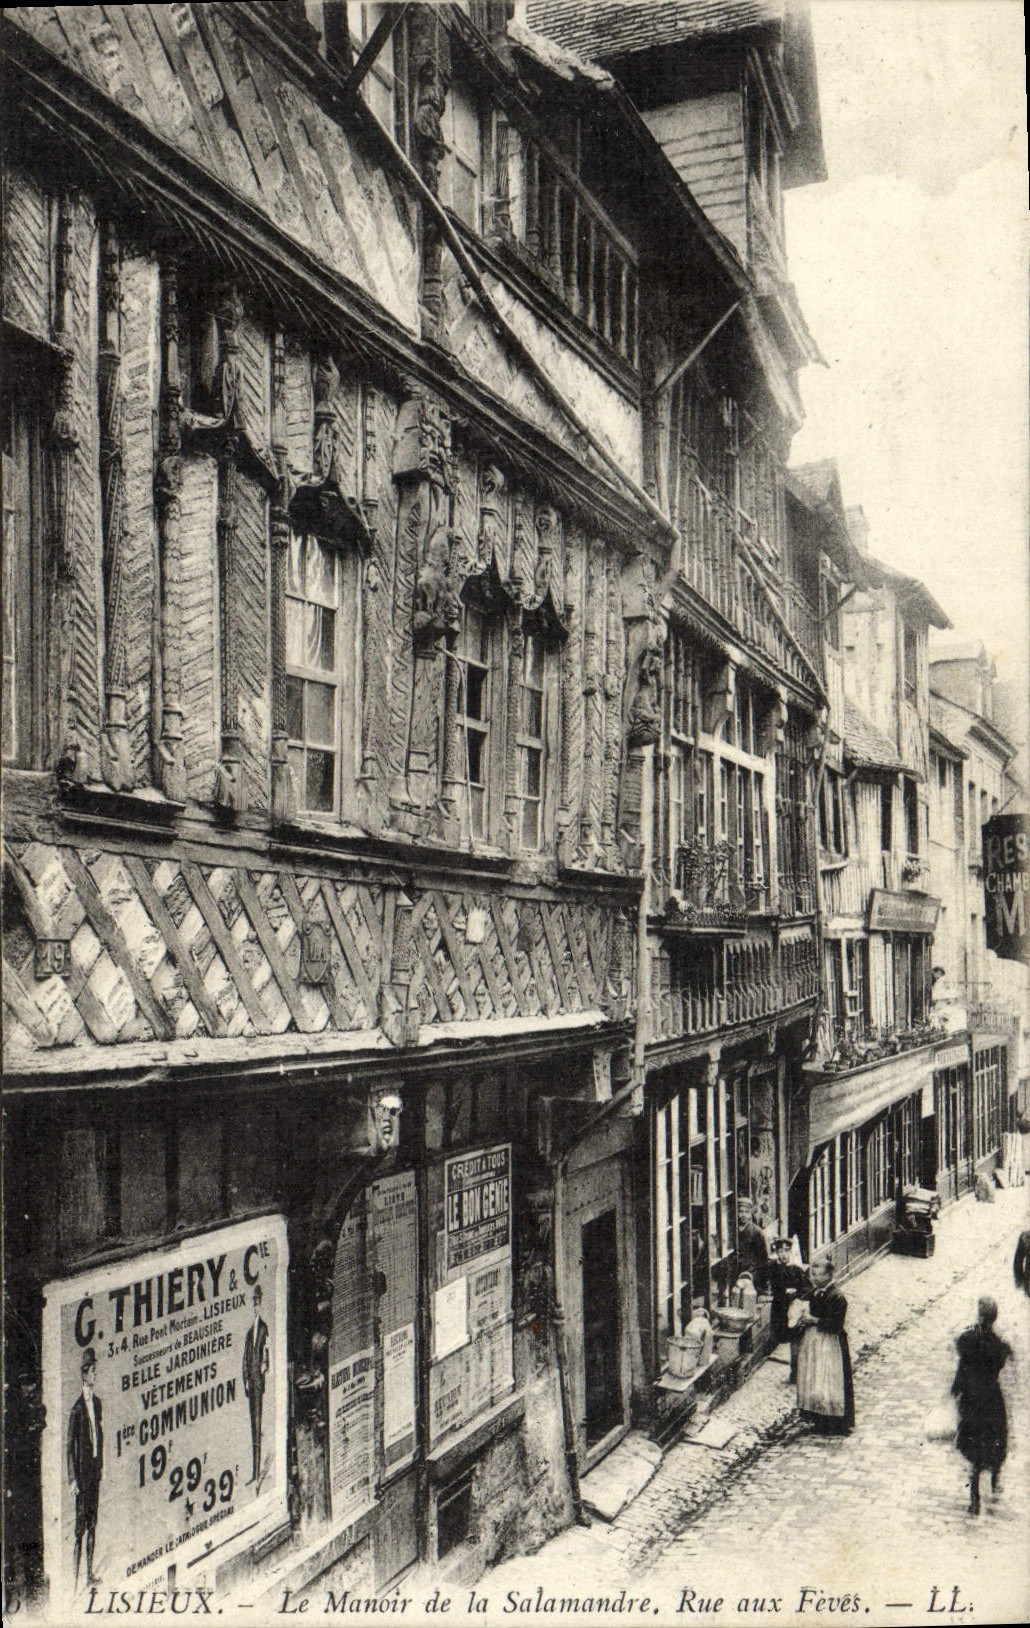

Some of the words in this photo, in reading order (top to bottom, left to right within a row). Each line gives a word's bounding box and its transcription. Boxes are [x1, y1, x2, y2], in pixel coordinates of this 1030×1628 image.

[448, 1193, 460, 1232] LE
[461, 1186, 481, 1227] BON
[74, 1297, 104, 1348] G.
[229, 1268, 238, 1292] &
[132, 1333, 149, 1349] Rue
[150, 1322, 168, 1341] Pont
[203, 1293, 247, 1321] LISIEUX
[174, 1338, 182, 1350] de
[183, 1319, 223, 1347] BEAUSIRE
[121, 1362, 161, 1392] BELLE
[139, 1378, 236, 1446] COMMUNION
[126, 1546, 163, 1578] DEMANDER
[165, 1541, 174, 1553] LE
